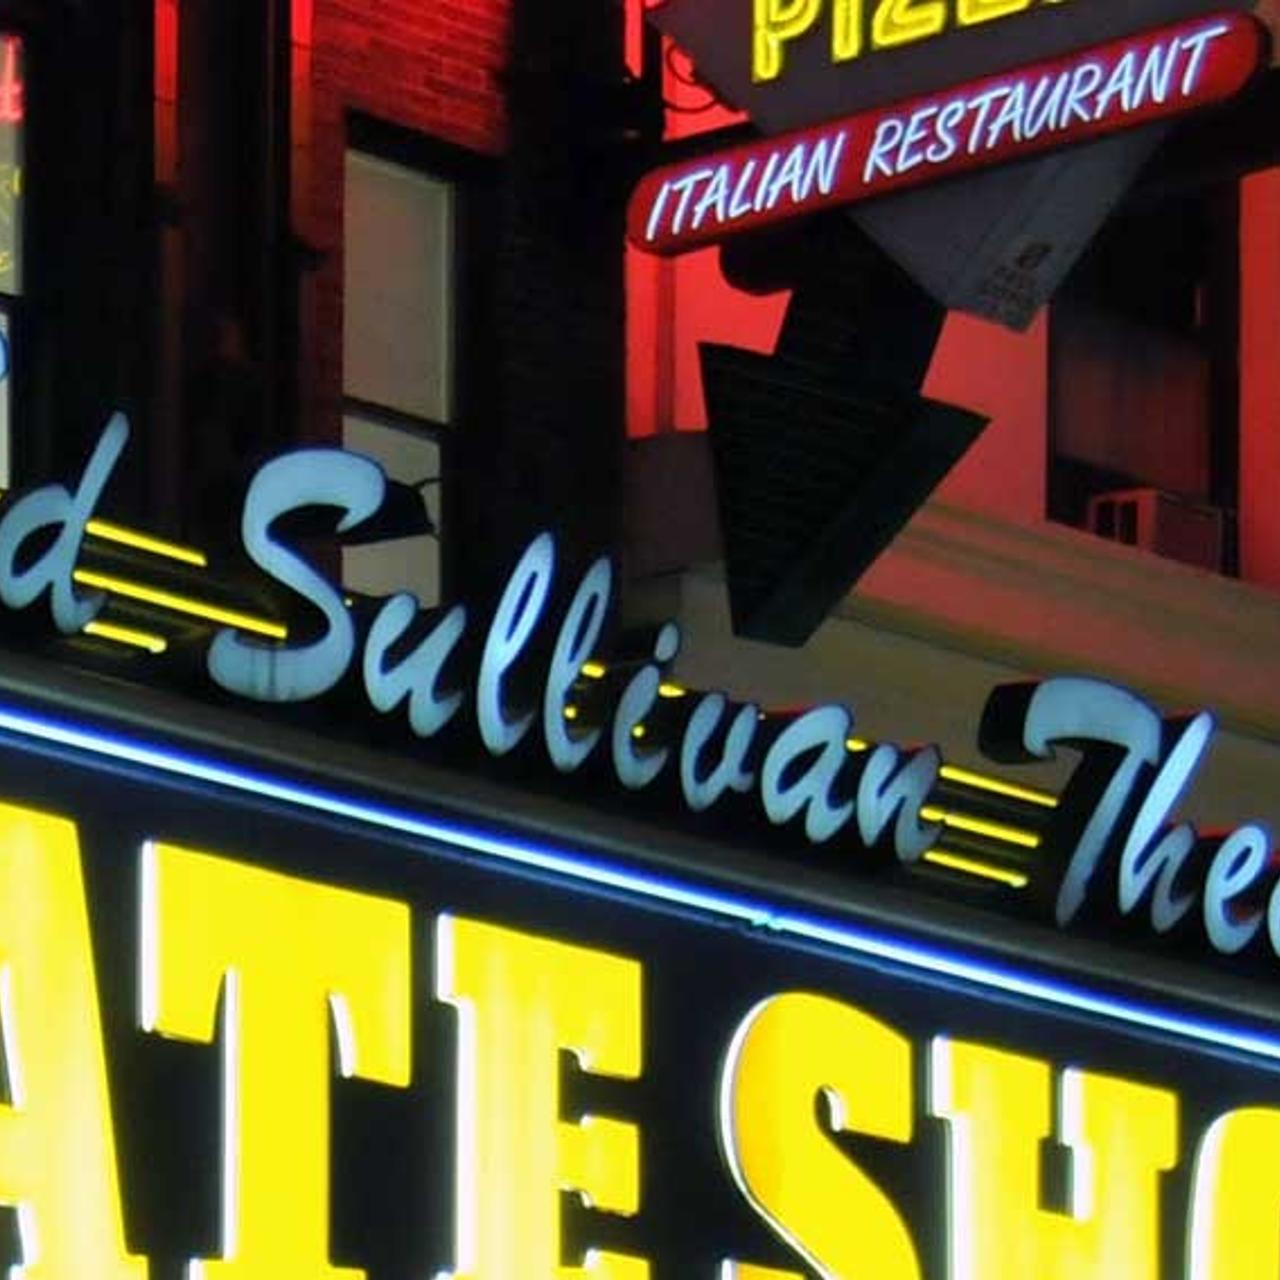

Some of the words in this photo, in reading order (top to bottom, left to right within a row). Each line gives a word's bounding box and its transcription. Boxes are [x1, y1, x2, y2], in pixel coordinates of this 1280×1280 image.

[646, 132, 844, 241] ITALIAN
[863, 25, 1227, 184] RESTAURANT
[208, 448, 943, 862] Sullivan
[1023, 677, 1280, 954] The
